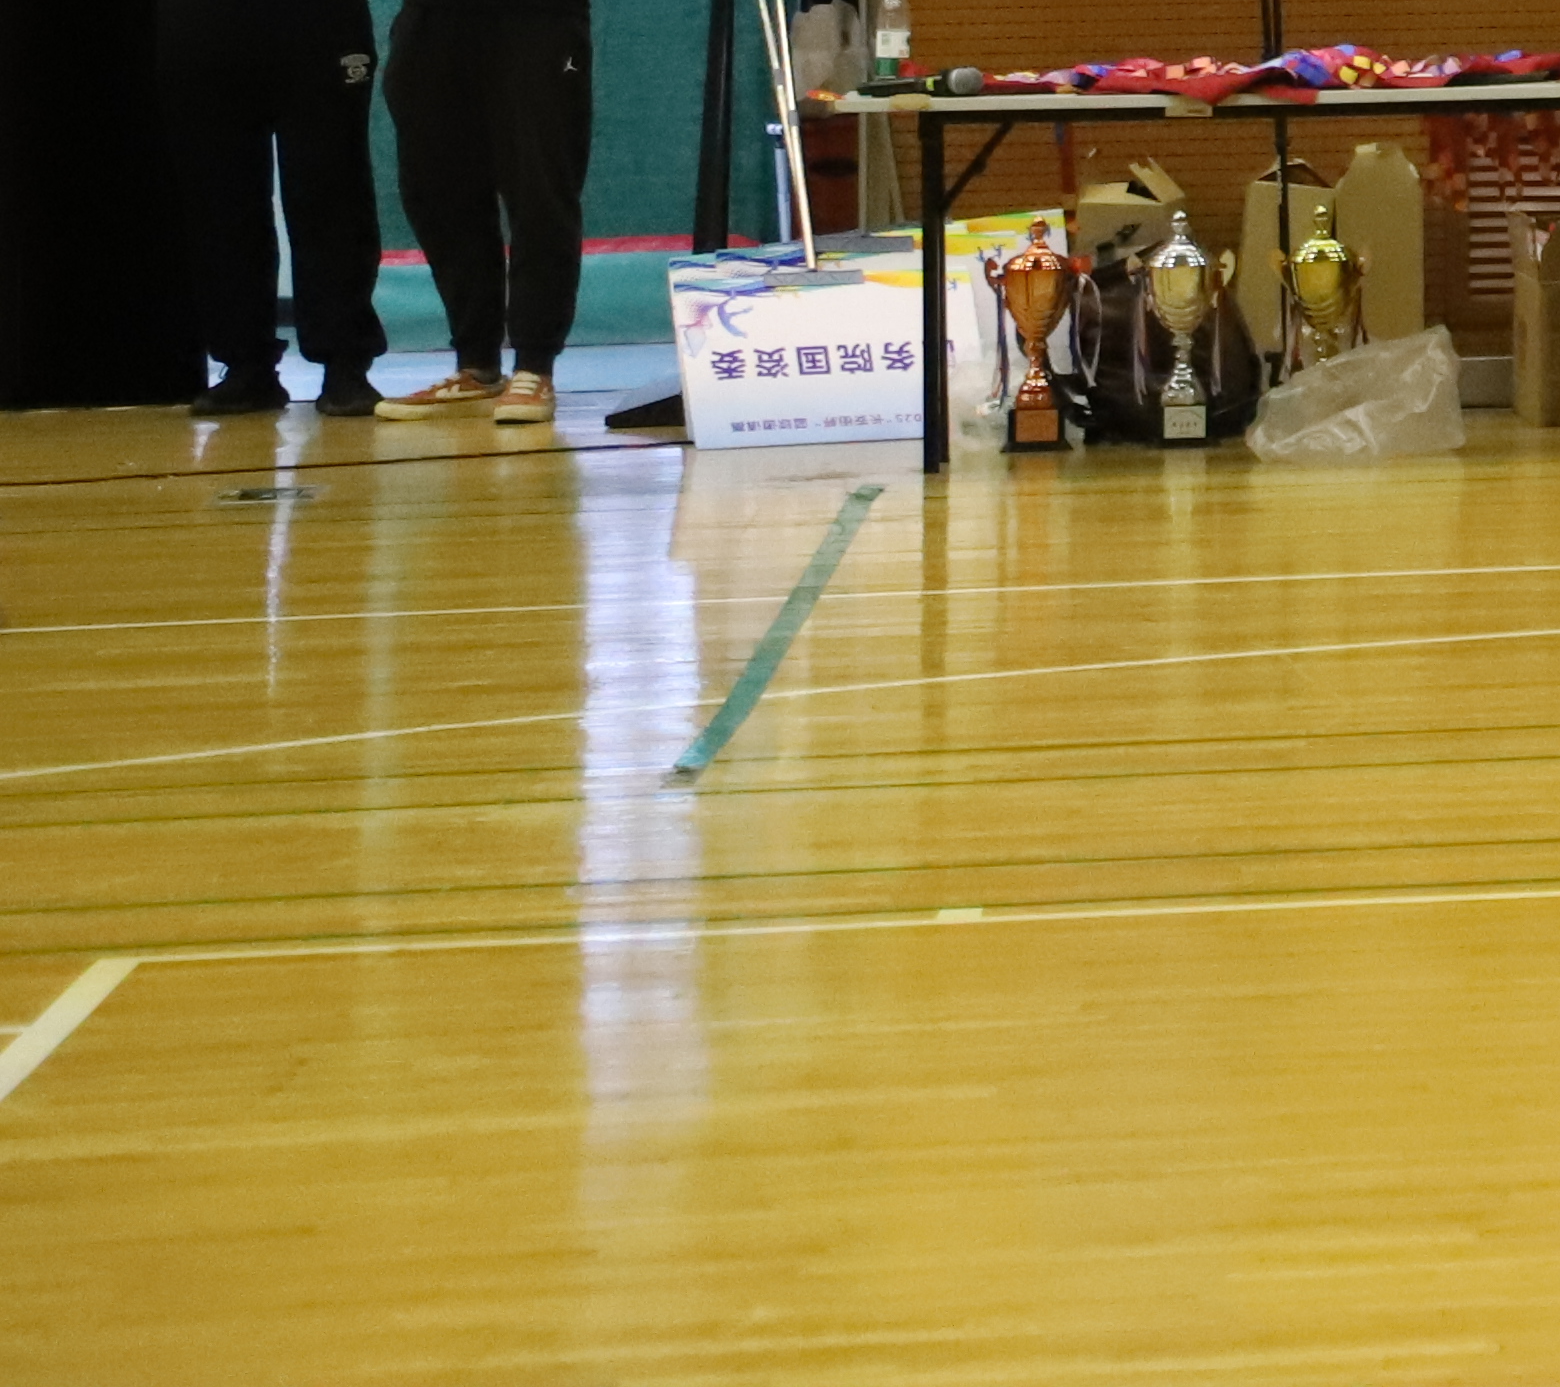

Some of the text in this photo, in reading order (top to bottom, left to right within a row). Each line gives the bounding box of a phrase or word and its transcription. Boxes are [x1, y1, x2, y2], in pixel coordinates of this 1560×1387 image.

[711, 339, 955, 381] 务院国资委
